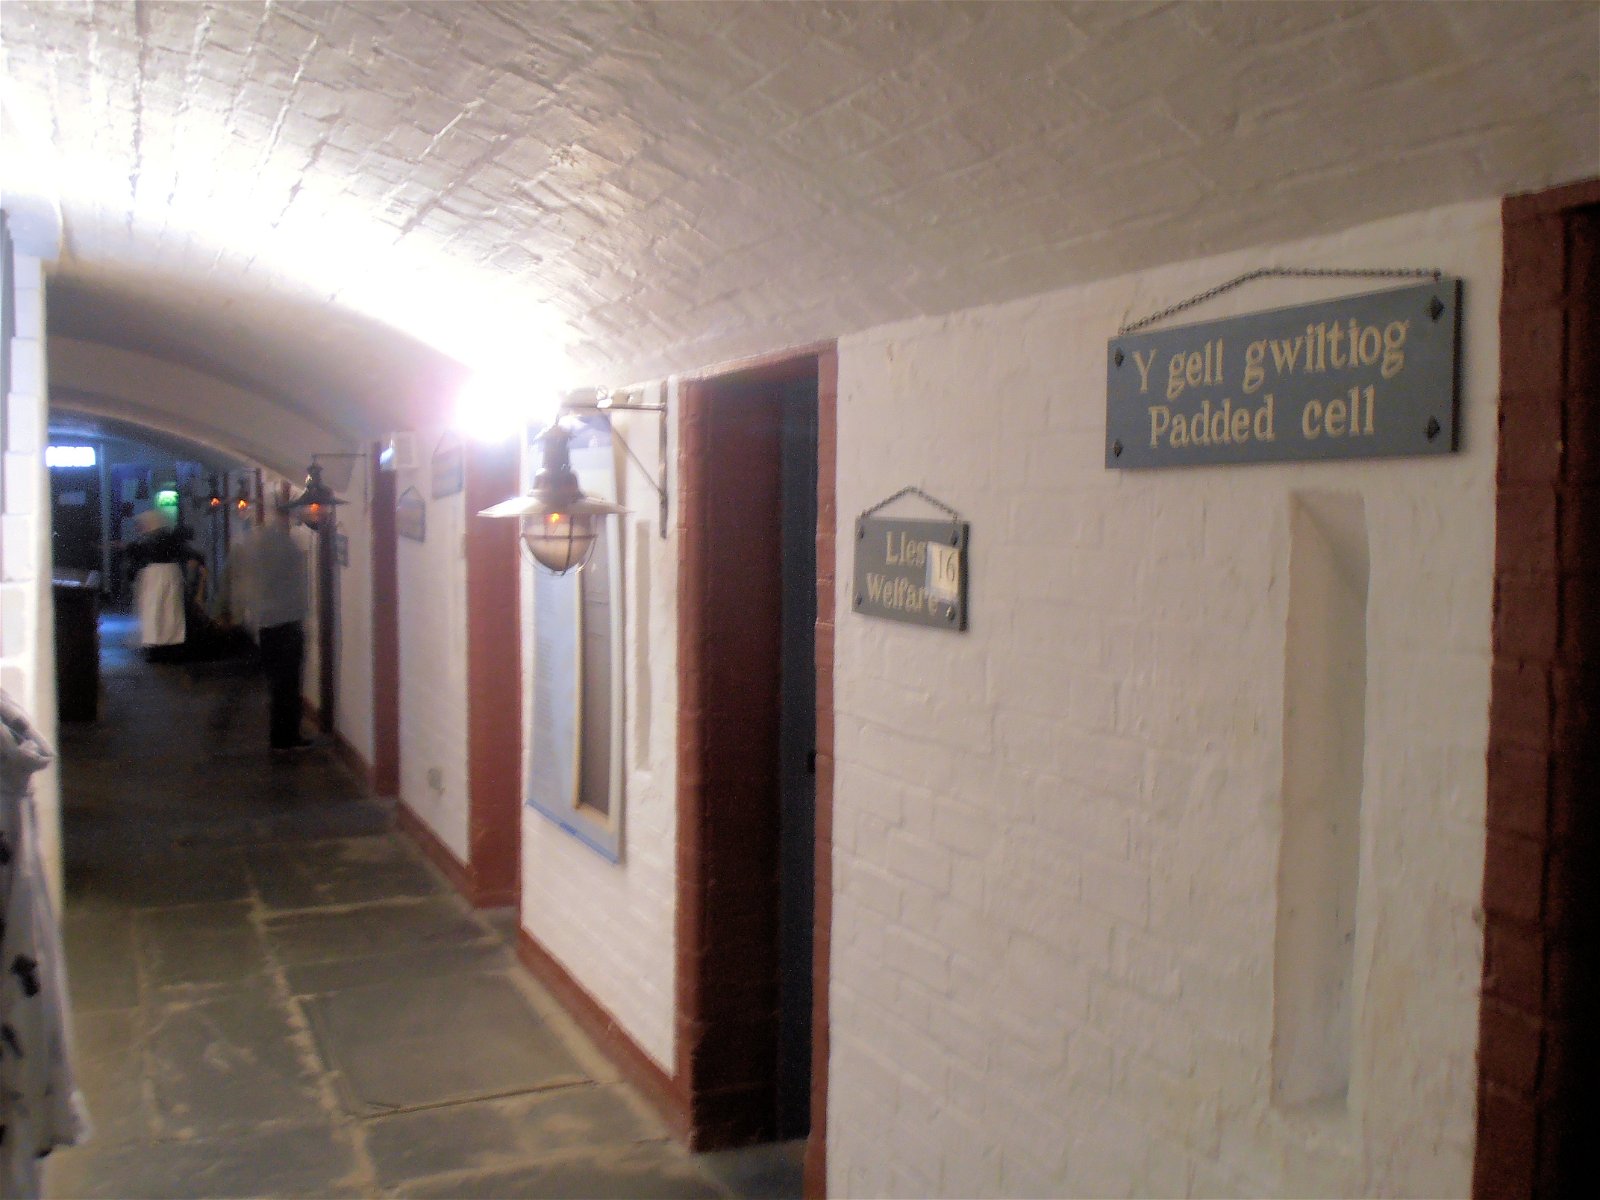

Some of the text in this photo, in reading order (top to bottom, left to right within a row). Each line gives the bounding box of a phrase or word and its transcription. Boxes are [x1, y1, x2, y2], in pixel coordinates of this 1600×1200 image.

[1132, 319, 1409, 398] Y gell gwiltiog
[1149, 385, 1376, 449] Padded cell
